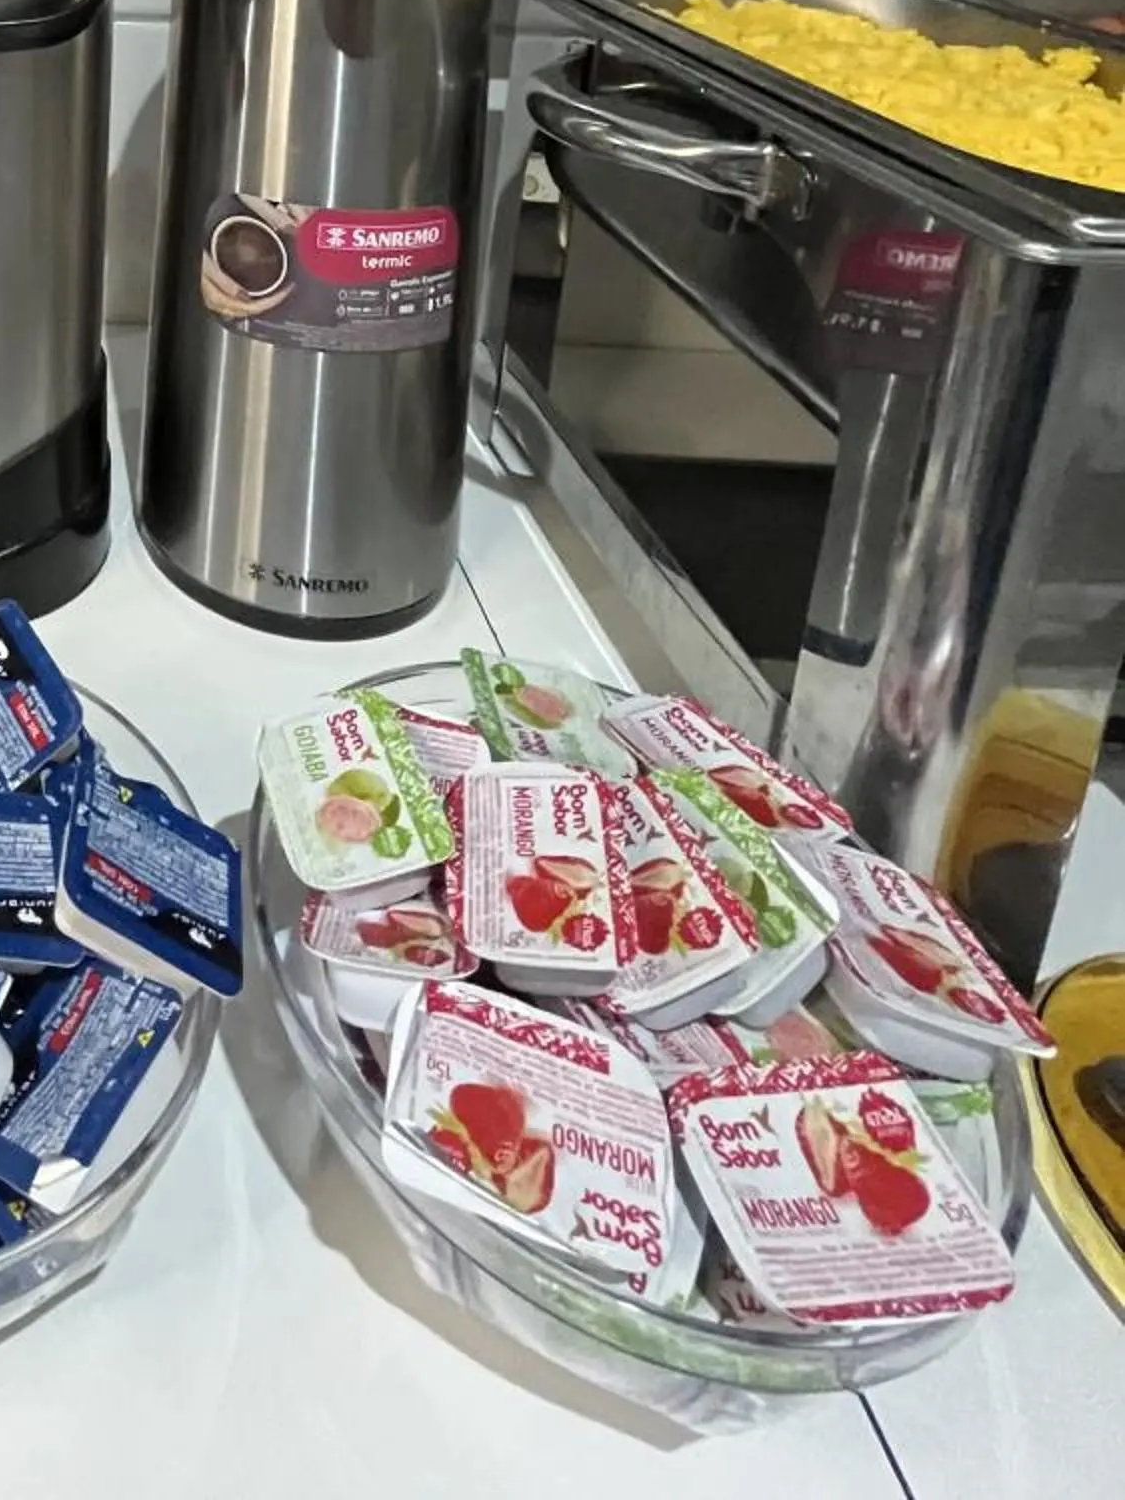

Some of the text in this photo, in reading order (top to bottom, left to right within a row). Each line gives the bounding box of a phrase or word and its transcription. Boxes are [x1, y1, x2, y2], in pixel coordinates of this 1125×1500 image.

[352, 227, 440, 248] SANREMO
[362, 254, 413, 269] termic
[272, 566, 371, 594] SANREMO
[326, 713, 353, 762] Sabor
[342, 708, 364, 750] Bom
[293, 725, 329, 782] GOIABA
[512, 786, 536, 857] MORANGO
[550, 785, 568, 836] Sabor
[569, 784, 587, 829] Bom
[615, 785, 646, 833] Bom
[426, 1054, 453, 1081] 15g
[698, 1113, 761, 1142] Bom
[551, 1123, 656, 1183] MORANGO
[710, 1140, 782, 1169] Sabor
[580, 1187, 661, 1240] Sabor
[739, 1195, 841, 1229] MORANGO
[938, 1201, 977, 1227] 15g
[593, 1217, 663, 1268] Bom
